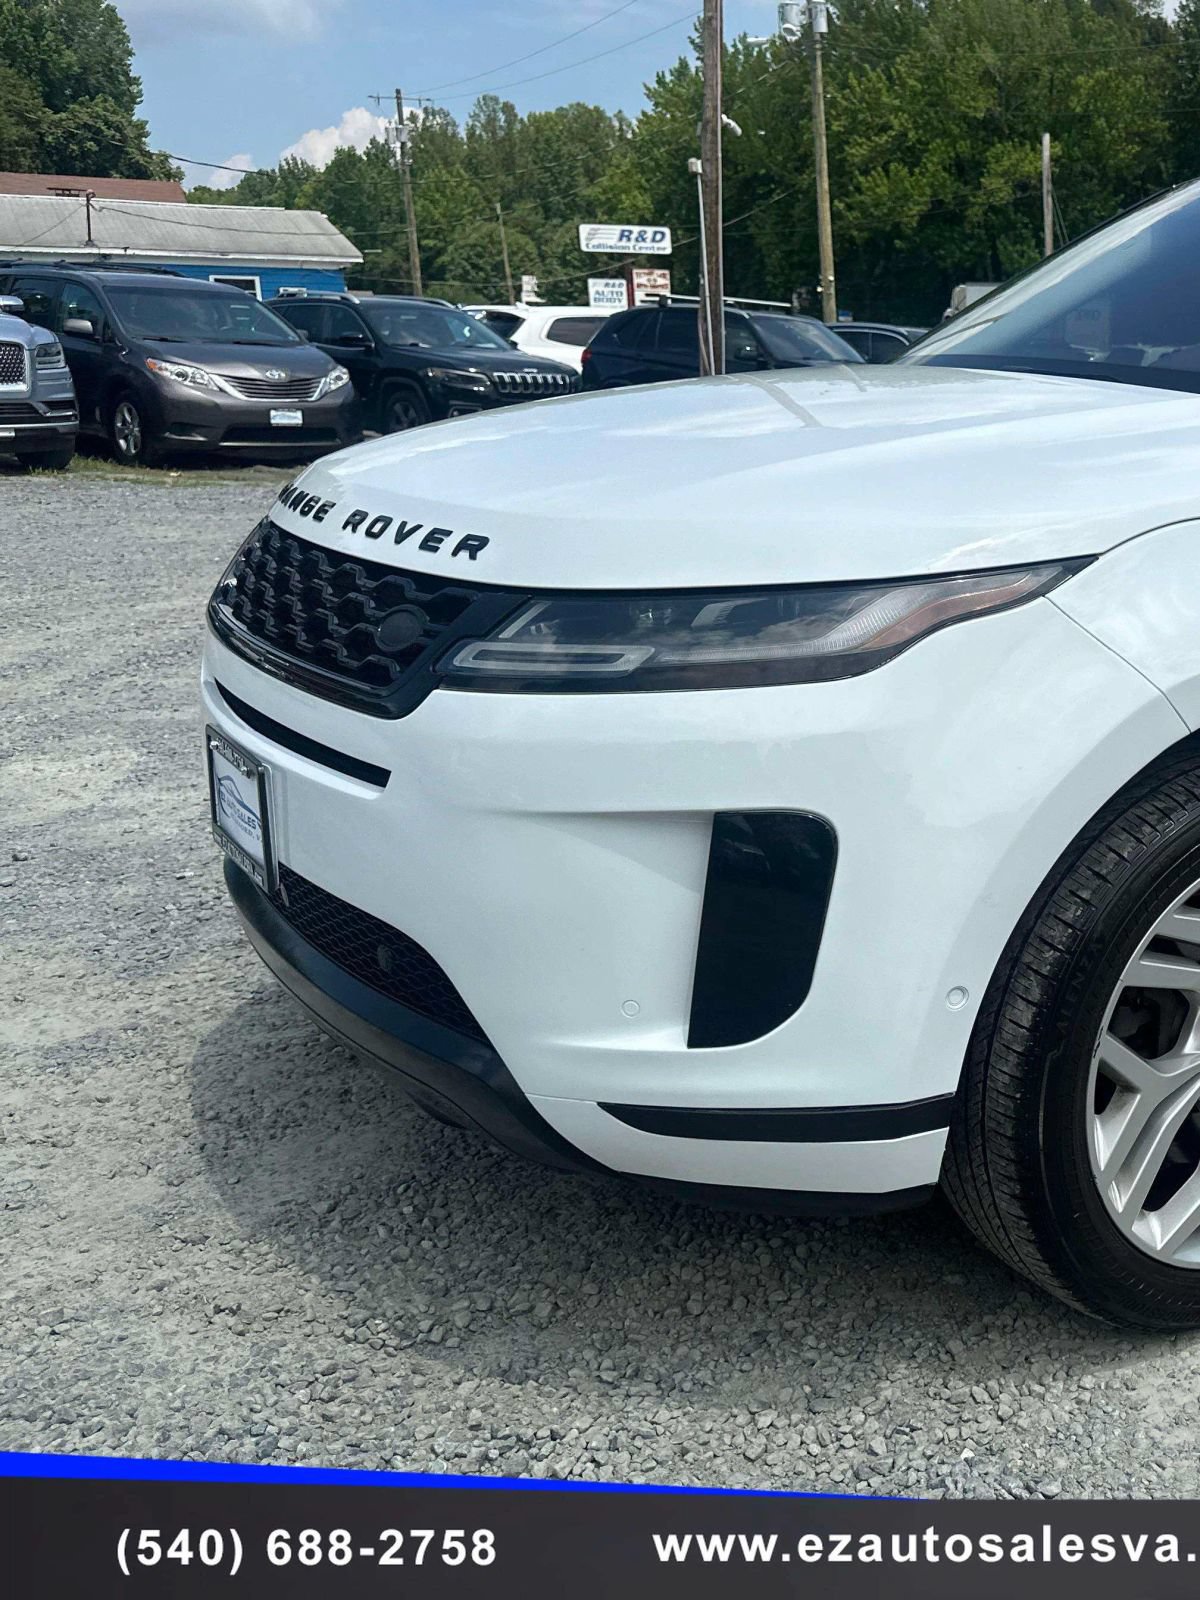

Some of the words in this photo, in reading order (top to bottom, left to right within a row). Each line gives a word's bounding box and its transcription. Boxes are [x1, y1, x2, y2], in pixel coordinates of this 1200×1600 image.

[585, 242, 630, 252] Collision
[632, 244, 667, 252] Center
[594, 290, 623, 298] AUTO
[278, 483, 337, 523] RANGE
[341, 508, 490, 561] ROVER
